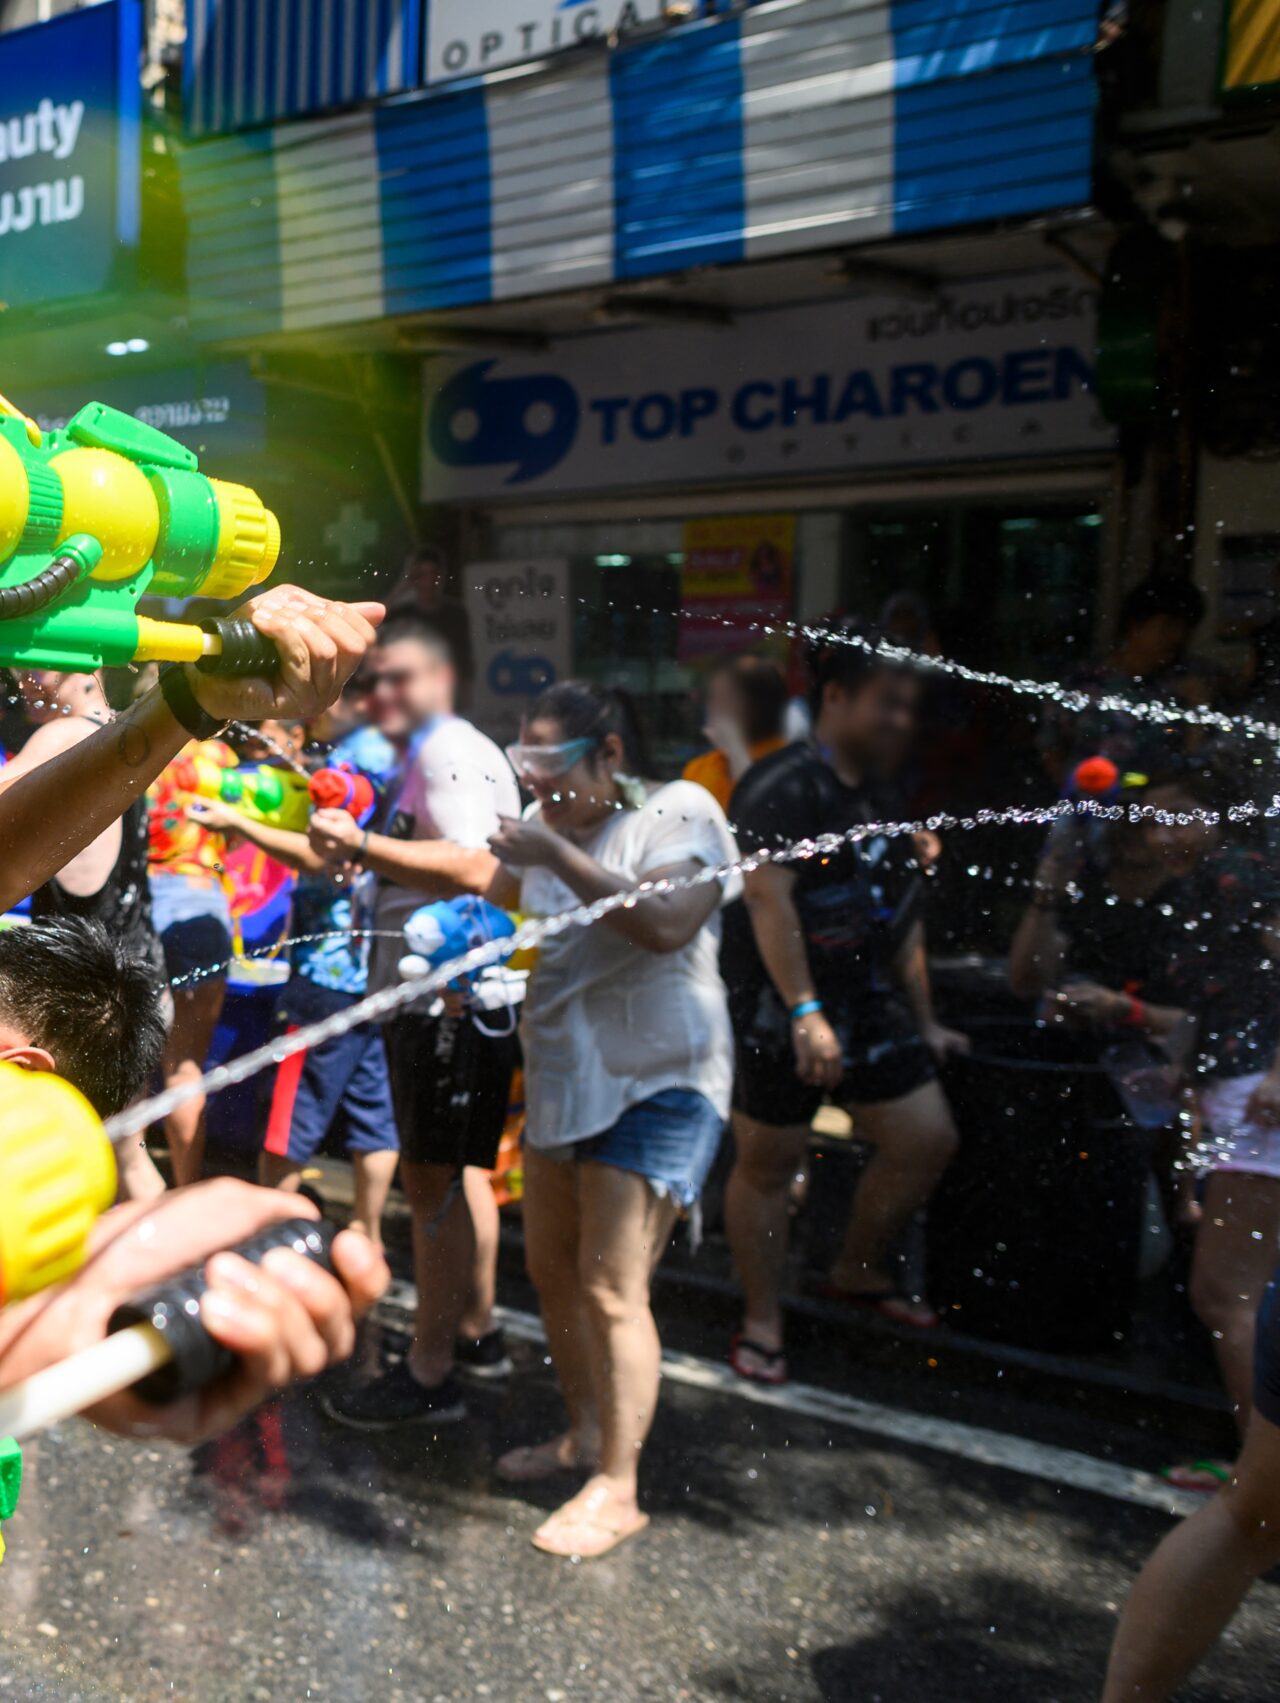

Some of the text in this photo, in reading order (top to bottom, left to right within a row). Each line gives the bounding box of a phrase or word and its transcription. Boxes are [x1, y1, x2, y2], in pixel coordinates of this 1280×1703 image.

[442, 0, 667, 71] OPTICA
[590, 346, 1098, 445] TOP CHAROEN
